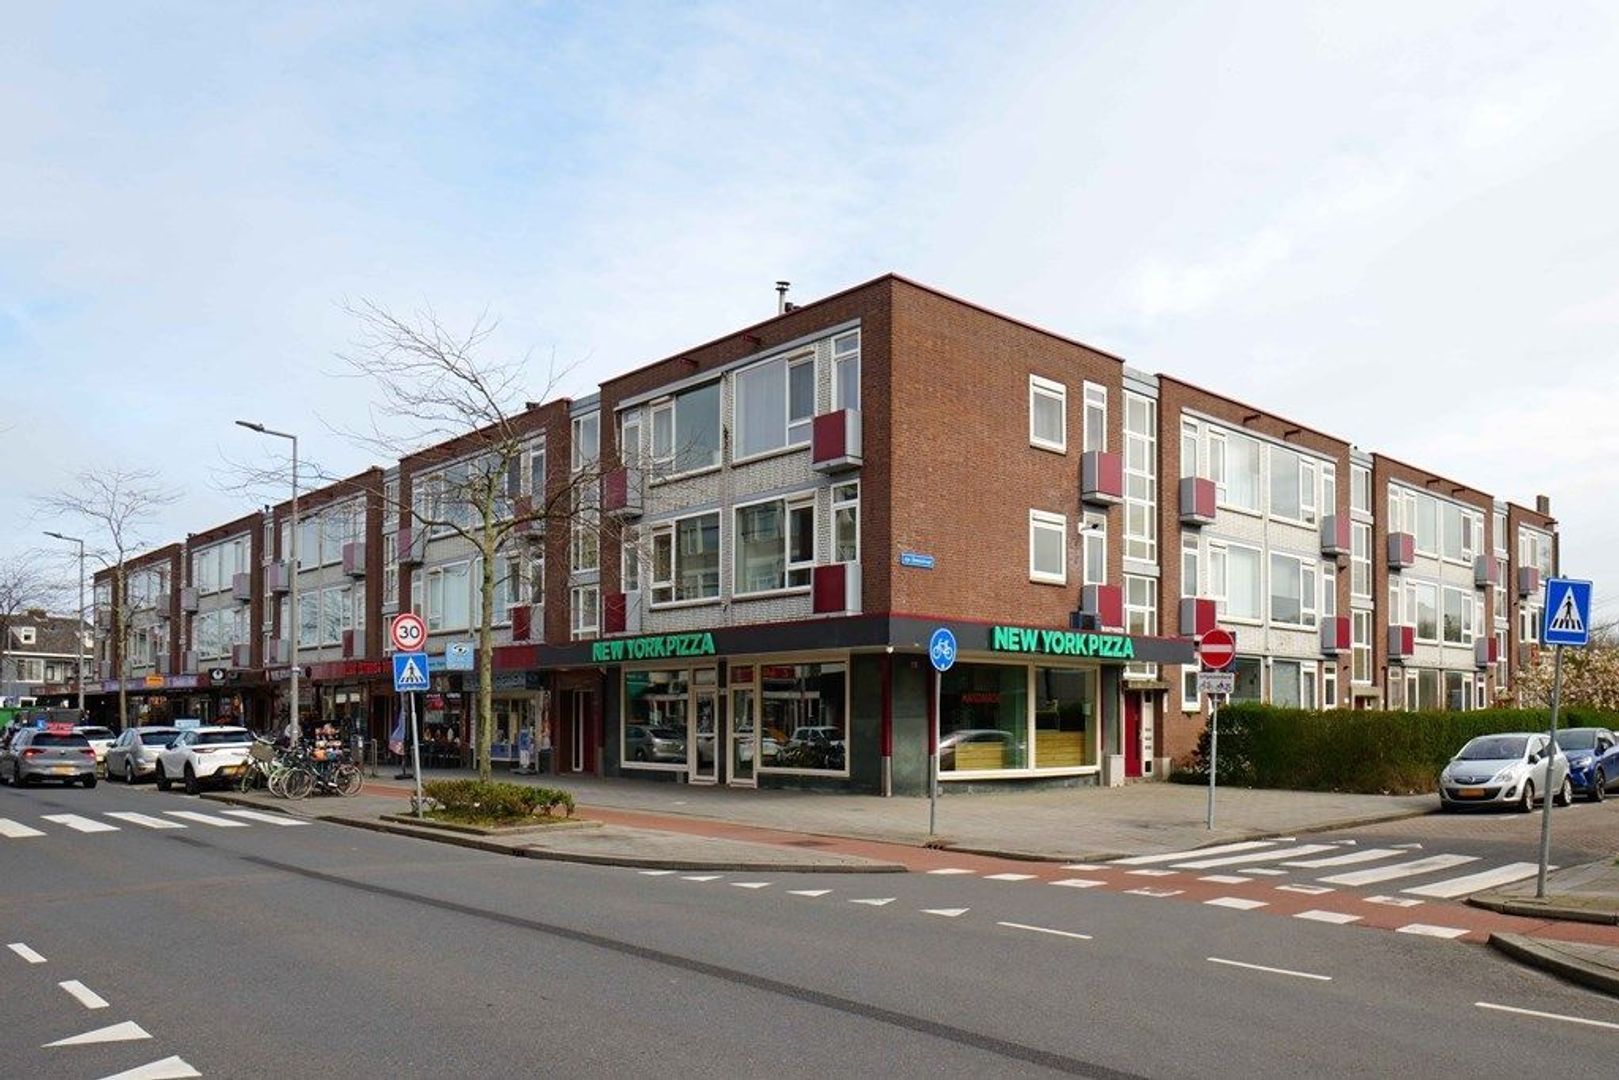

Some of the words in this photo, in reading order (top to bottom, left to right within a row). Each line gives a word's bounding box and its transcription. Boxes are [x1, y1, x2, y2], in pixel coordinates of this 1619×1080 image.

[399, 625, 420, 639] 30
[593, 641, 623, 661] NEW
[626, 637, 665, 659] YORK
[665, 632, 715, 656] PIZZA
[994, 625, 1039, 652] NEW
[1040, 629, 1087, 655] YORK
[1088, 634, 1135, 658] PIZZA
